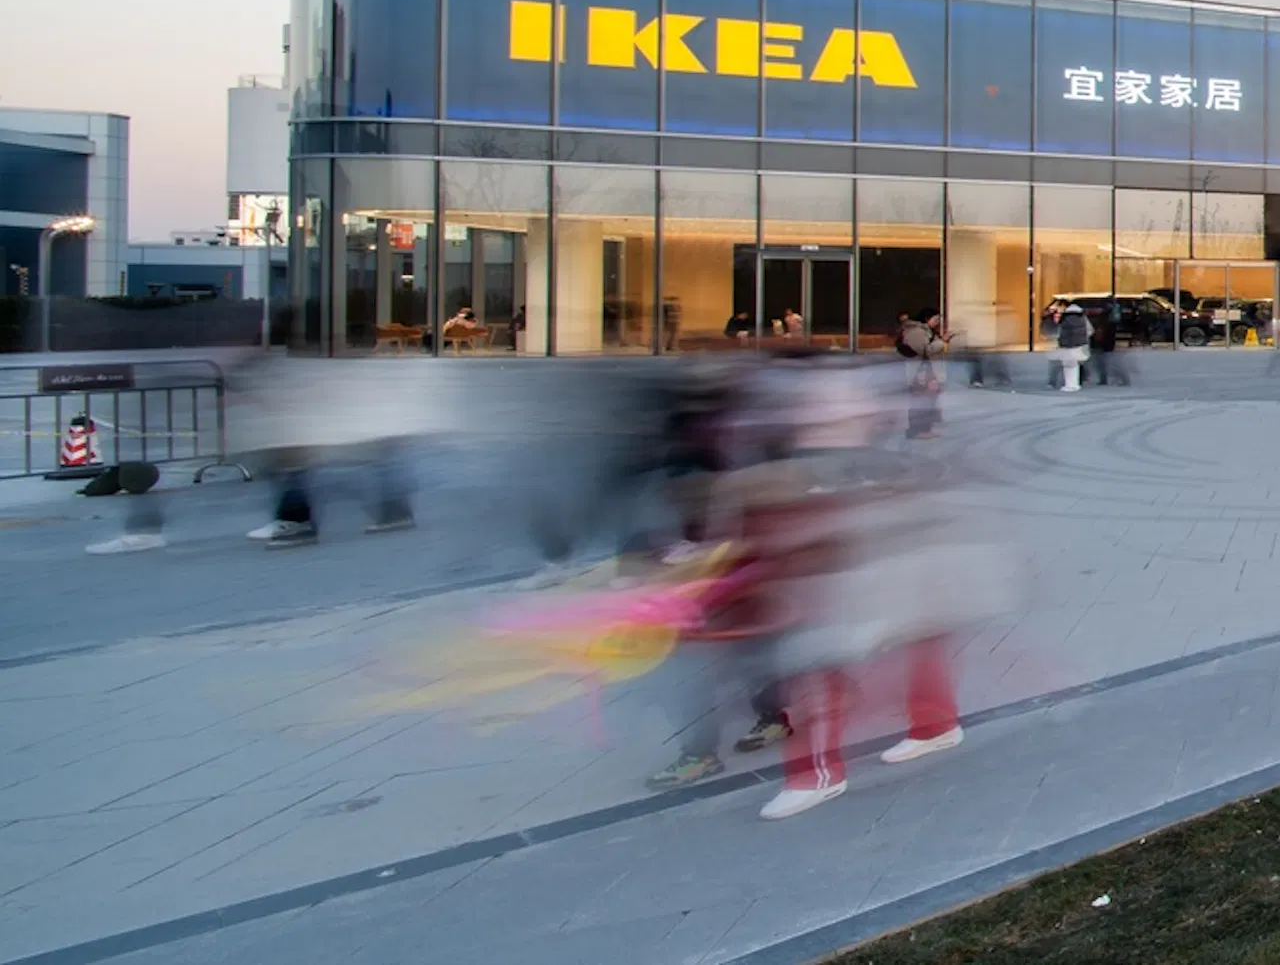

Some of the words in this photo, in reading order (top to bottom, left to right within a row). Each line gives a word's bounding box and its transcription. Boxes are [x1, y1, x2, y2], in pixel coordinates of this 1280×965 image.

[508, 0, 919, 89] IKEA
[1063, 66, 1243, 112] 宜家家居
